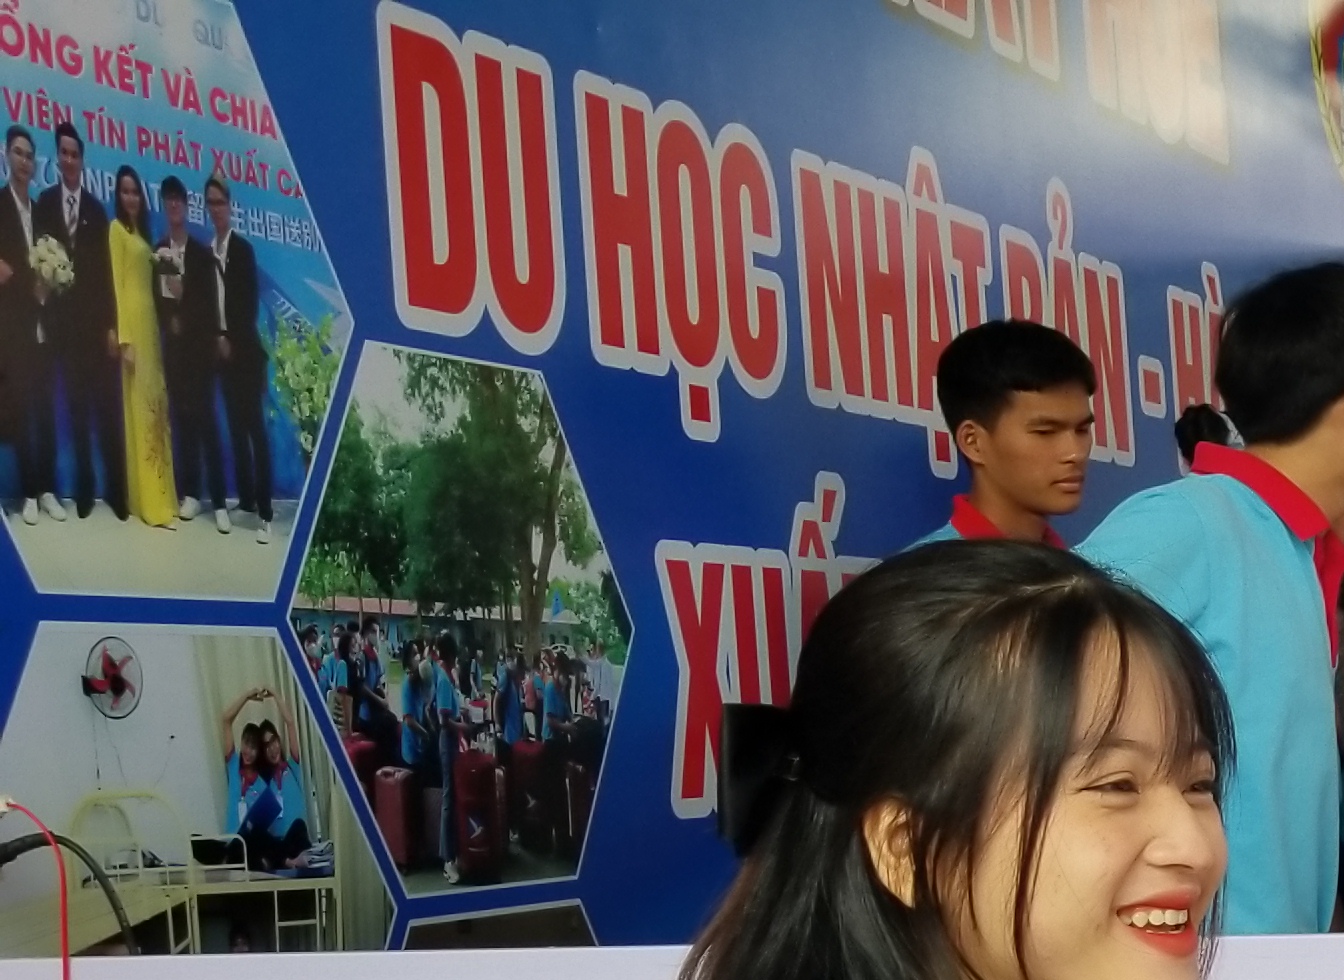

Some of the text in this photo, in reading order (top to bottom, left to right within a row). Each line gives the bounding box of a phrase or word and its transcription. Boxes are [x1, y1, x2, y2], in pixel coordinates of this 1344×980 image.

[93, 43, 153, 99] KẾT
[161, 66, 204, 117] VÀ
[209, 86, 278, 140] CHIA
[82, 107, 128, 151] TÍN
[136, 126, 203, 170] PHÁT
[211, 146, 269, 191] XUẤT
[386, 16, 557, 340] DU
[580, 87, 781, 428] HỌC
[796, 158, 990, 468] NHẬT
